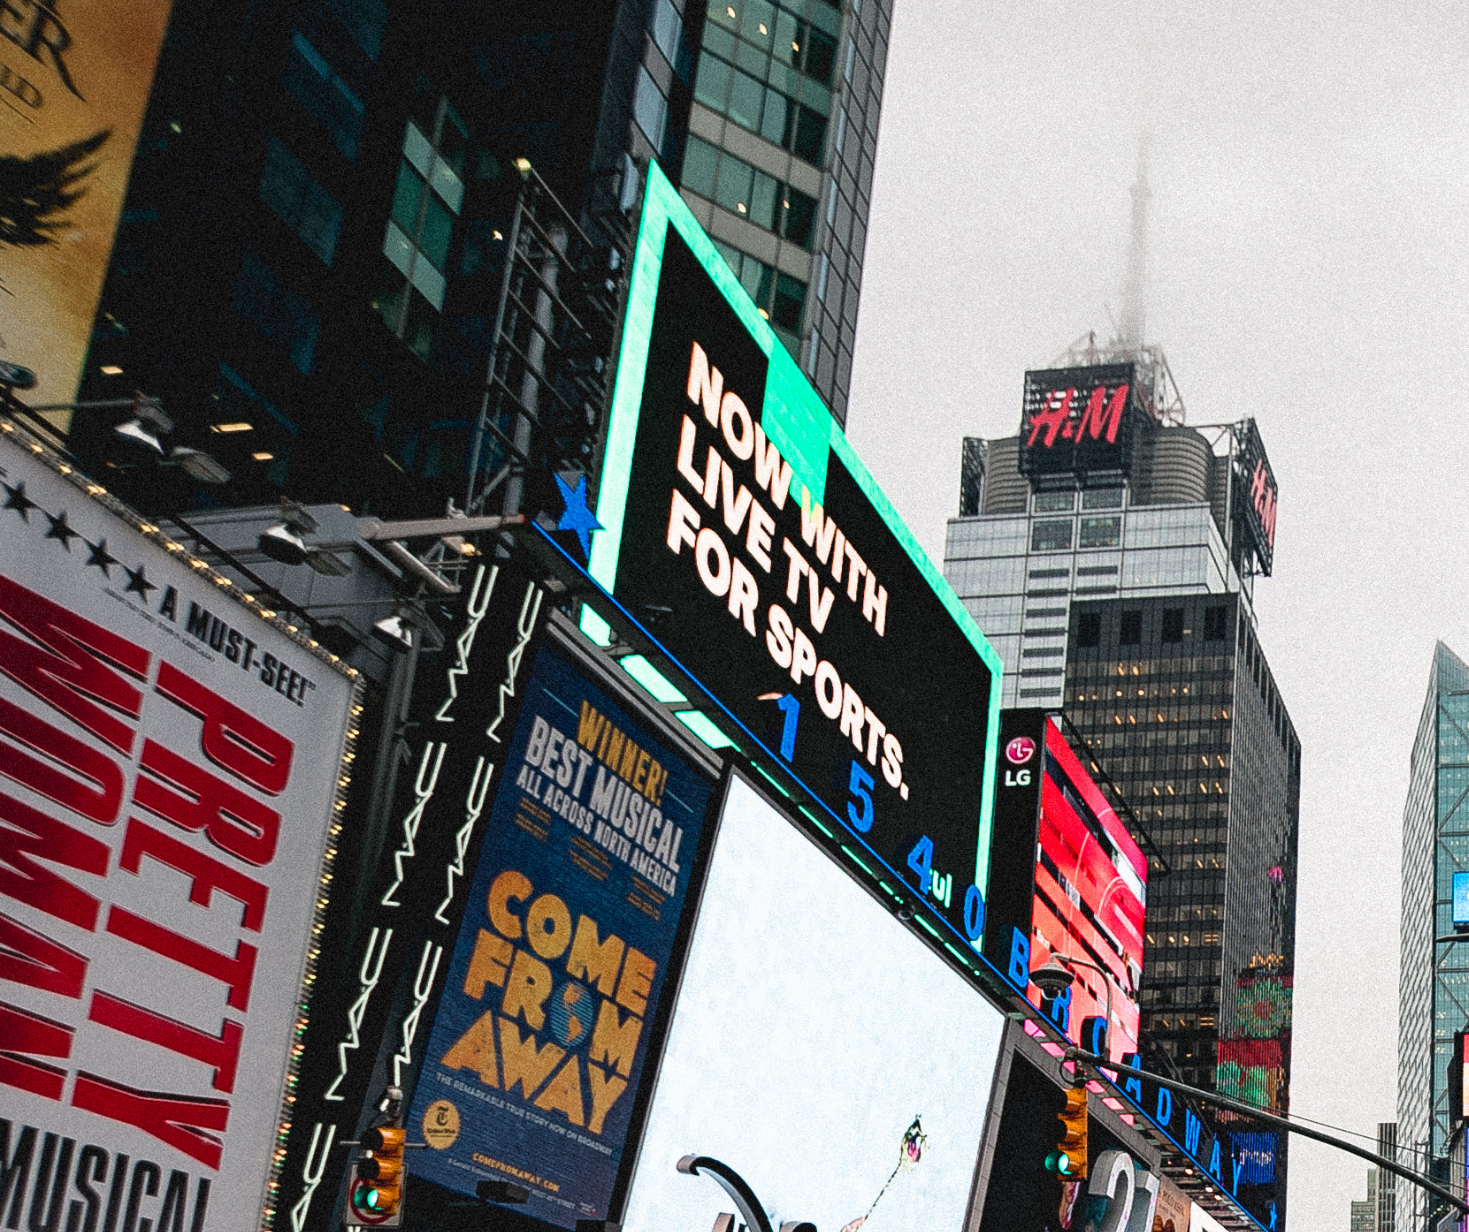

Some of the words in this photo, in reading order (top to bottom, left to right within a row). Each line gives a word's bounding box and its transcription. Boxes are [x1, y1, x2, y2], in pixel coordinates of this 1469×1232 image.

[1027, 383, 1129, 448] H&M
[677, 414, 776, 573] LIVE
[783, 536, 835, 634] TV
[687, 341, 793, 511] NOW
[801, 484, 888, 637] WITH
[160, 584, 179, 622] A
[666, 488, 759, 637] FOR
[766, 604, 909, 800] SPORTS.
[524, 714, 592, 798] BEST
[588, 766, 683, 873] MUSICAL
[577, 700, 669, 807] WINNER!
[1005, 769, 1031, 787] LG
[516, 765, 541, 801] ALL
[543, 783, 594, 835] ACROSS
[592, 820, 631, 863] NORTH
[628, 846, 677, 897] AMERICA
[70, 658, 296, 1172] PRETTY
[487, 870, 657, 1017] COME
[439, 1008, 629, 1135] AWAY
